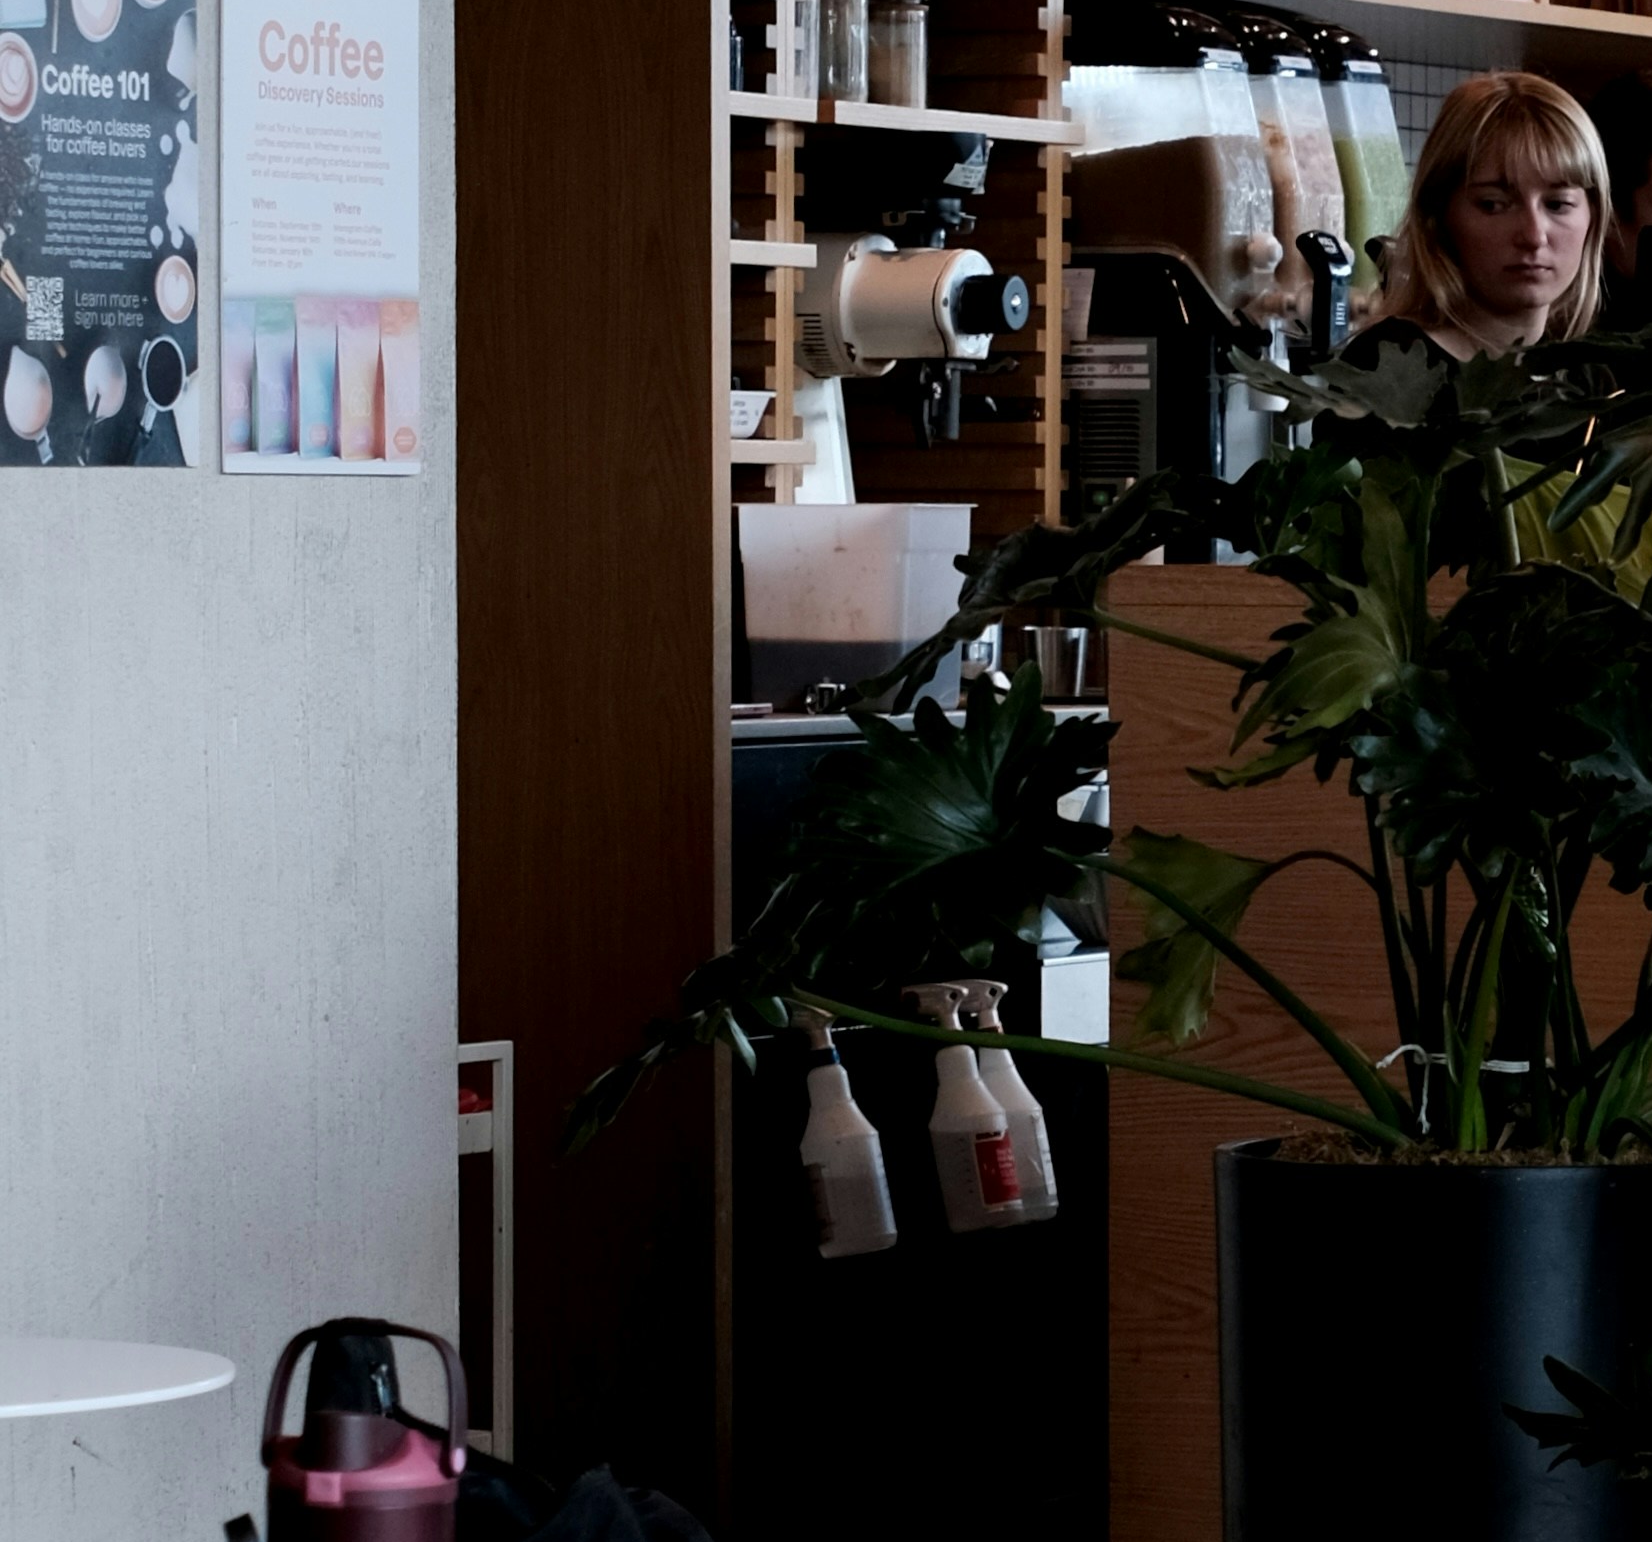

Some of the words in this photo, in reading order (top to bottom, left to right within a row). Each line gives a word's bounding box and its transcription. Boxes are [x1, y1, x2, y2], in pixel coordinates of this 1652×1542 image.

[259, 20, 384, 80] Coffee
[41, 64, 114, 98] Coffee
[117, 70, 150, 101] 101
[259, 80, 324, 107] Discovery
[326, 86, 384, 109] Sessions
[41, 114, 101, 135] Hands-on
[104, 118, 151, 139] classes
[46, 135, 63, 153] for
[66, 136, 107, 155] coffee
[109, 139, 146, 158] lovers
[252, 198, 277, 209] When
[333, 202, 362, 216] Where
[75, 289, 107, 308] Learn
[110, 294, 140, 308] more
[142, 296, 149, 304] +
[75, 307, 98, 329] sign
[101, 312, 116, 328] up
[118, 310, 144, 327] here
